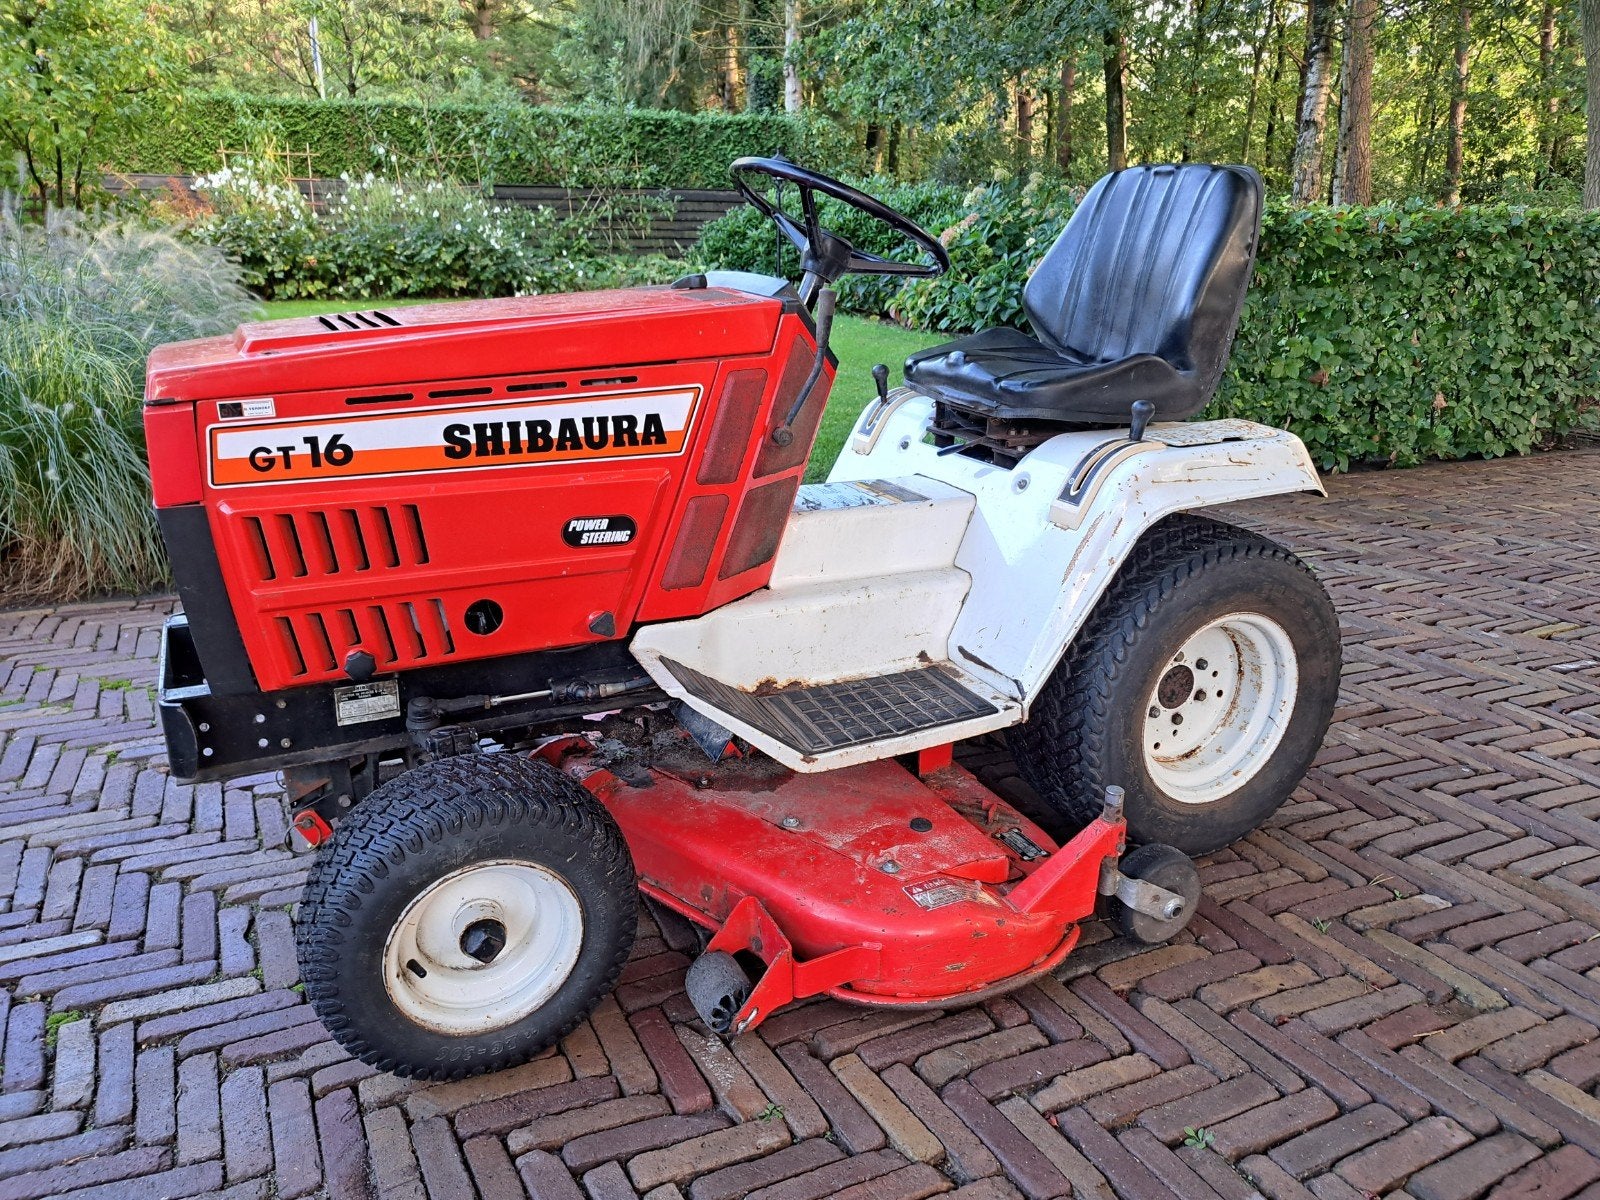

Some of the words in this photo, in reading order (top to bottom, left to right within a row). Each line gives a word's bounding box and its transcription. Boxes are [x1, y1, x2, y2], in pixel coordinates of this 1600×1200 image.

[442, 413, 668, 459] SHIBAURA
[248, 446, 296, 473] GT
[302, 433, 354, 467] 16
[568, 518, 609, 531] POWER
[580, 530, 631, 544] STEERING
